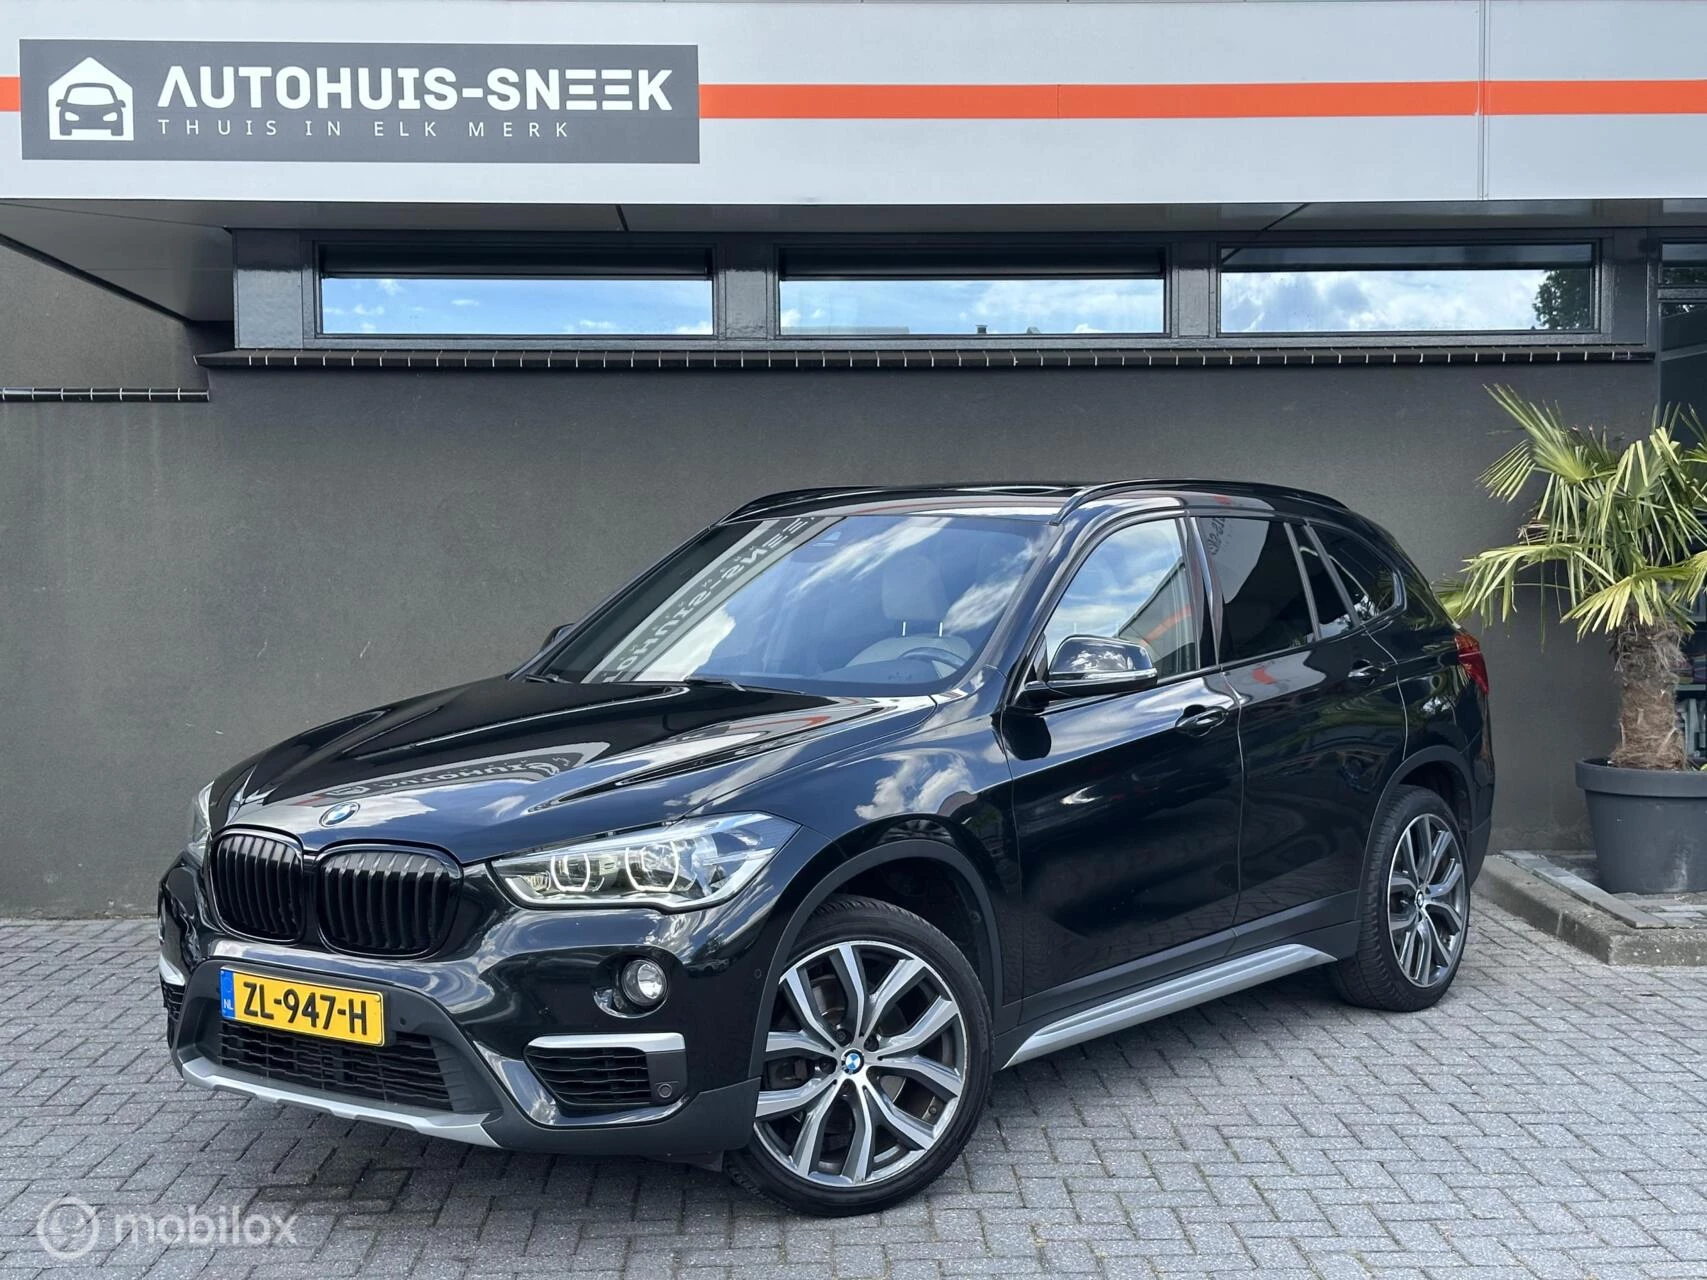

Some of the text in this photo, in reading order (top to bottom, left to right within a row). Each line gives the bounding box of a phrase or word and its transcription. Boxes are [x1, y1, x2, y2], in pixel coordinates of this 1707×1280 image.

[157, 65, 673, 111] AUTOHUIS-SNEEK
[158, 118, 568, 138] THUIS IN ELK MERK
[223, 998, 234, 1010] NL
[243, 981, 368, 1036] ZL-947-H
